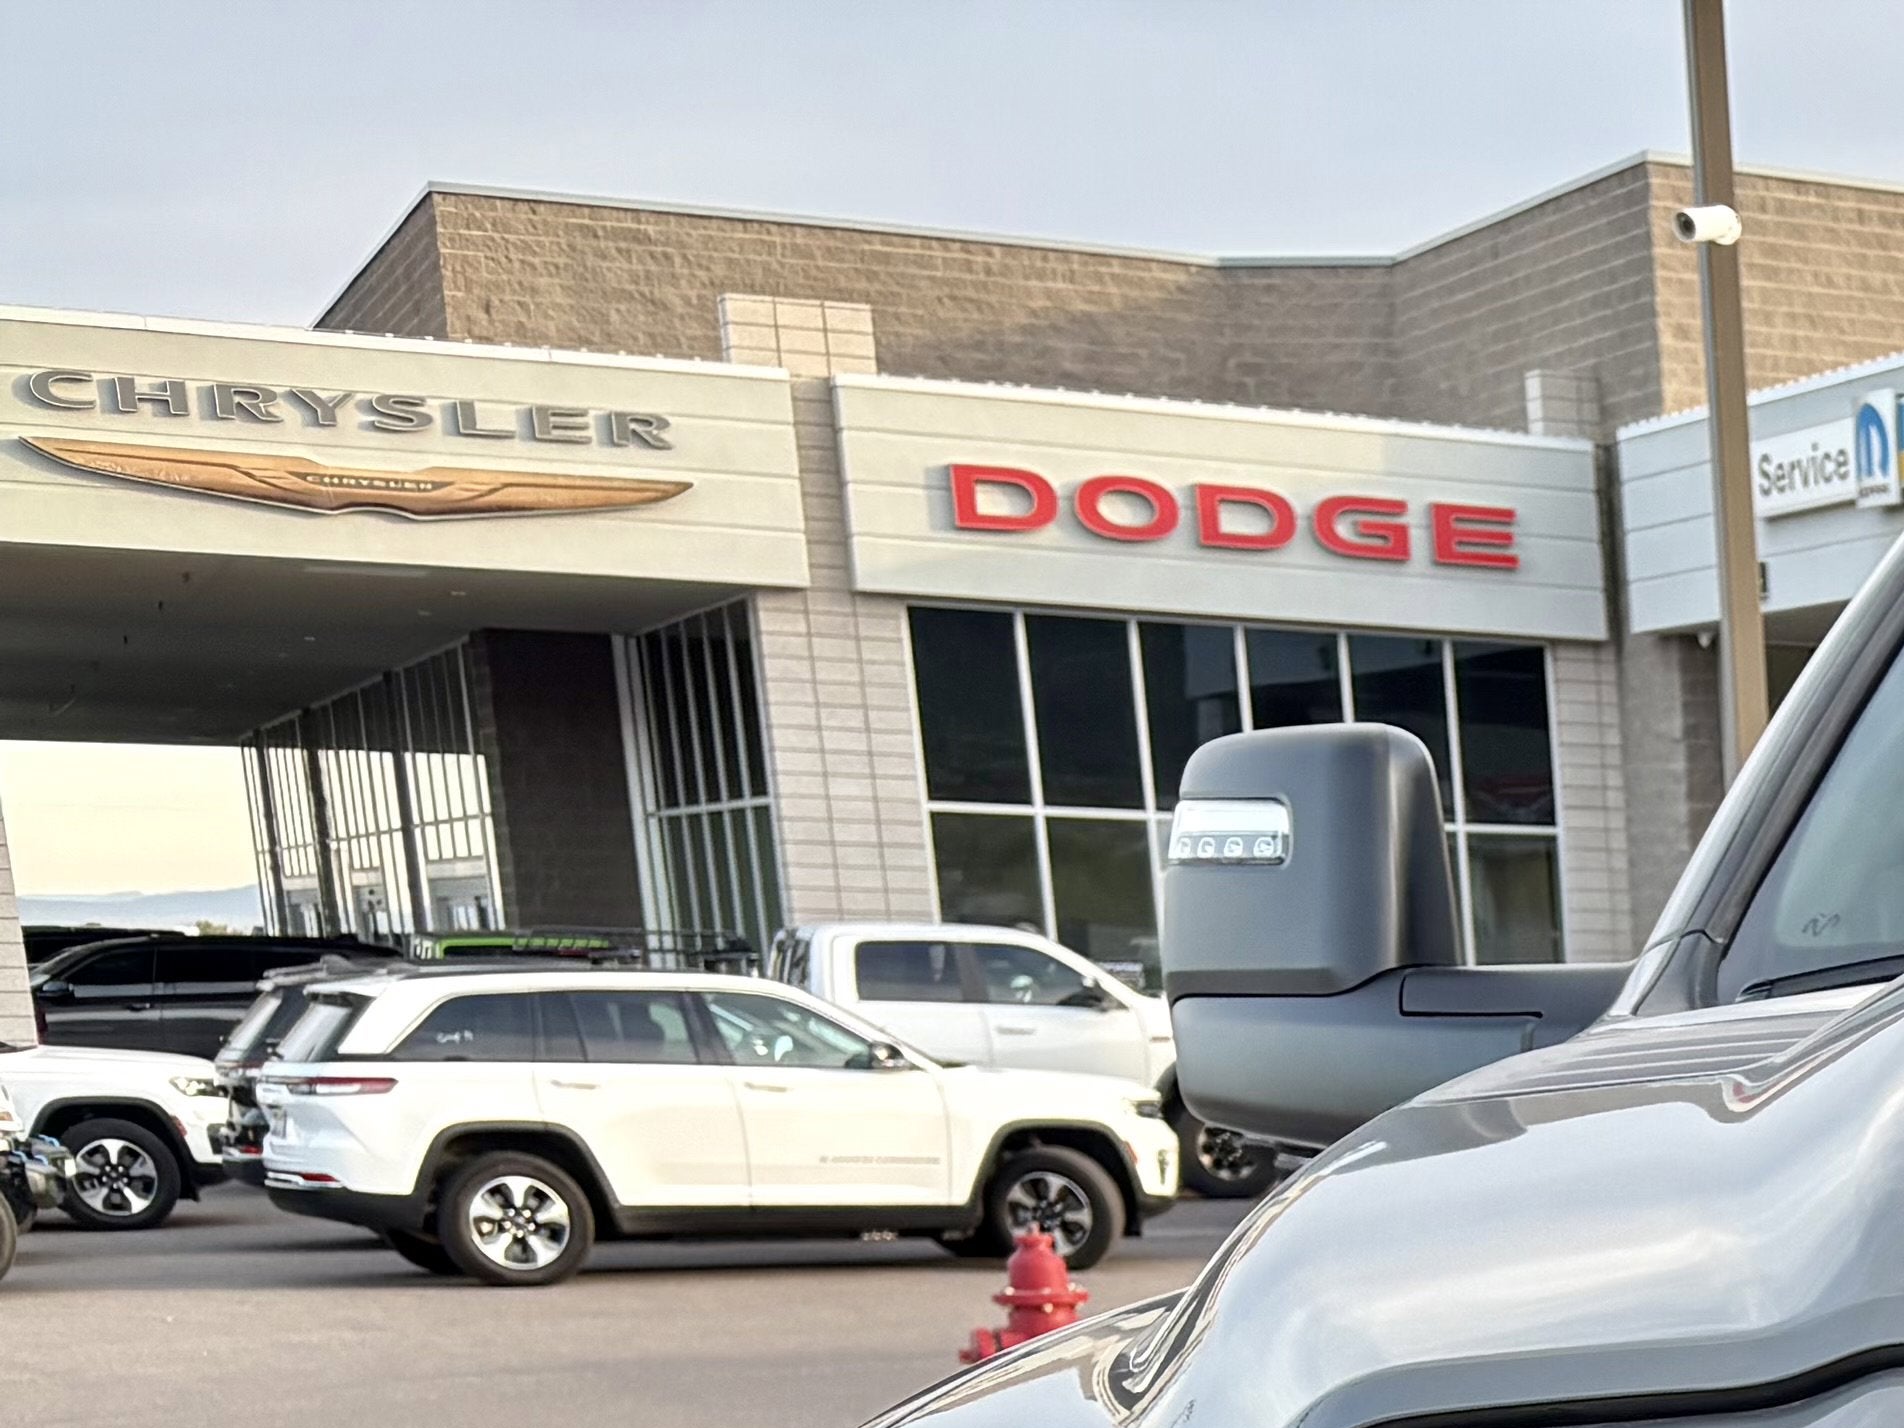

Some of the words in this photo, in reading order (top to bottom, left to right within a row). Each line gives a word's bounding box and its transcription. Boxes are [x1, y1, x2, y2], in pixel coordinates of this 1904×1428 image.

[28, 369, 675, 451] CHRYSLER
[1757, 442, 1849, 497] Service
[949, 463, 1521, 570] DODGE
